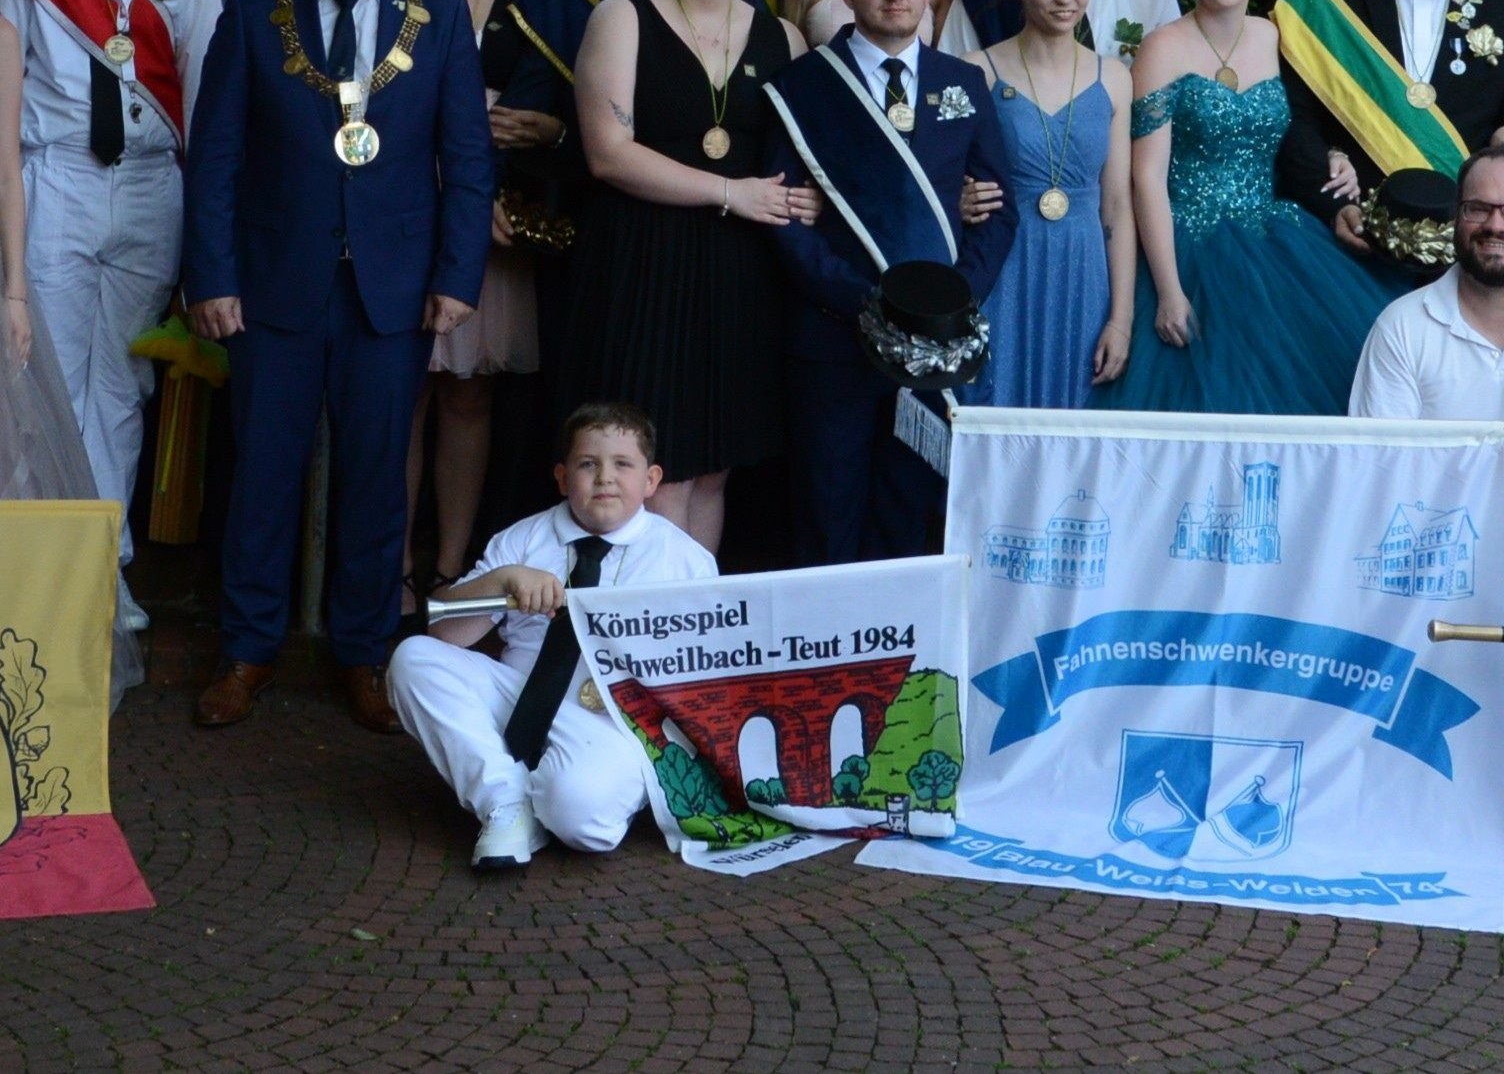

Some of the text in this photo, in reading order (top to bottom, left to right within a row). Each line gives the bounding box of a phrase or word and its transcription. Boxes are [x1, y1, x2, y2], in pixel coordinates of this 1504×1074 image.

[586, 600, 749, 640] Königsspiel
[593, 640, 762, 678] Schweilbach
[782, 634, 841, 661] Teut
[851, 624, 915, 654] 1984
[1054, 639, 1395, 694] Fahnenschwenkergruppe
